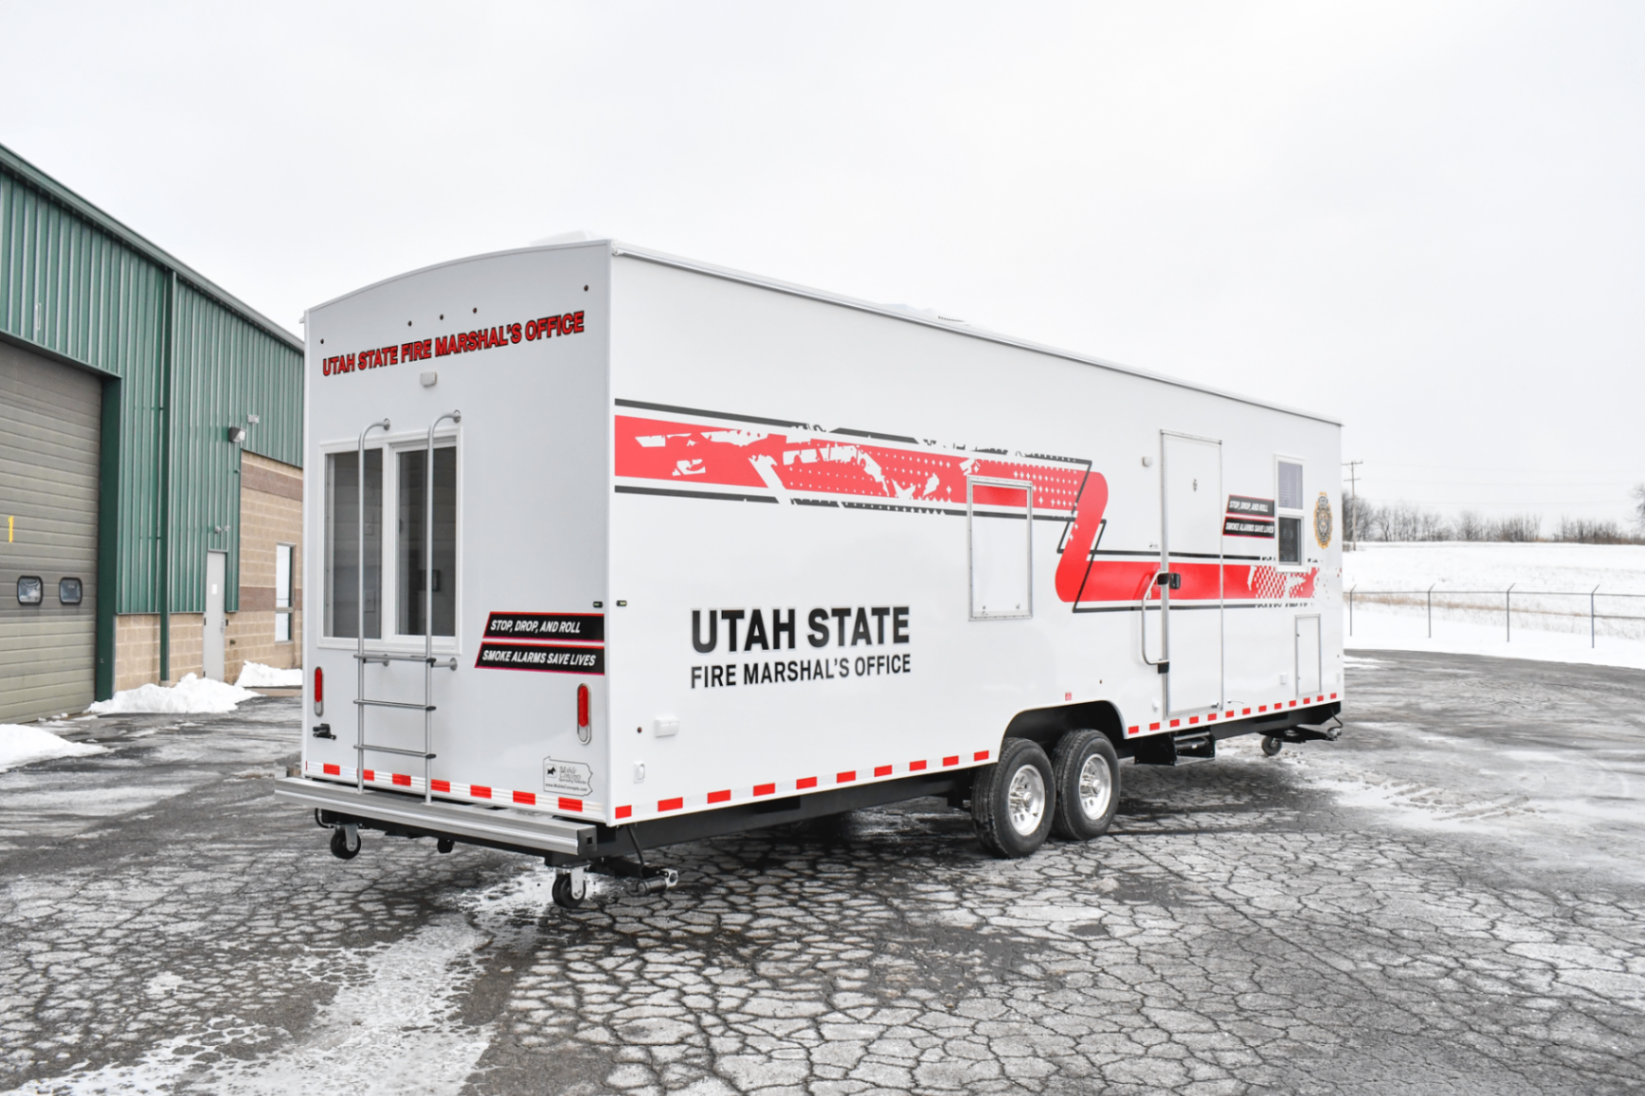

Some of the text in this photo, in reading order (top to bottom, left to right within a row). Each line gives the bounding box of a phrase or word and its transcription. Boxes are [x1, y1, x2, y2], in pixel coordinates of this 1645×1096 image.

[322, 311, 585, 376] UTAH STATE FIRE MARSHAL'S OFFICE
[490, 619, 581, 634] STOP, DROP, AND ROLL
[691, 606, 910, 654] UTAH STATE
[482, 650, 596, 666] SMOKE ALARMS SAVE LIVES
[691, 653, 911, 689] FIRE MARSHAL'S OFFICE
